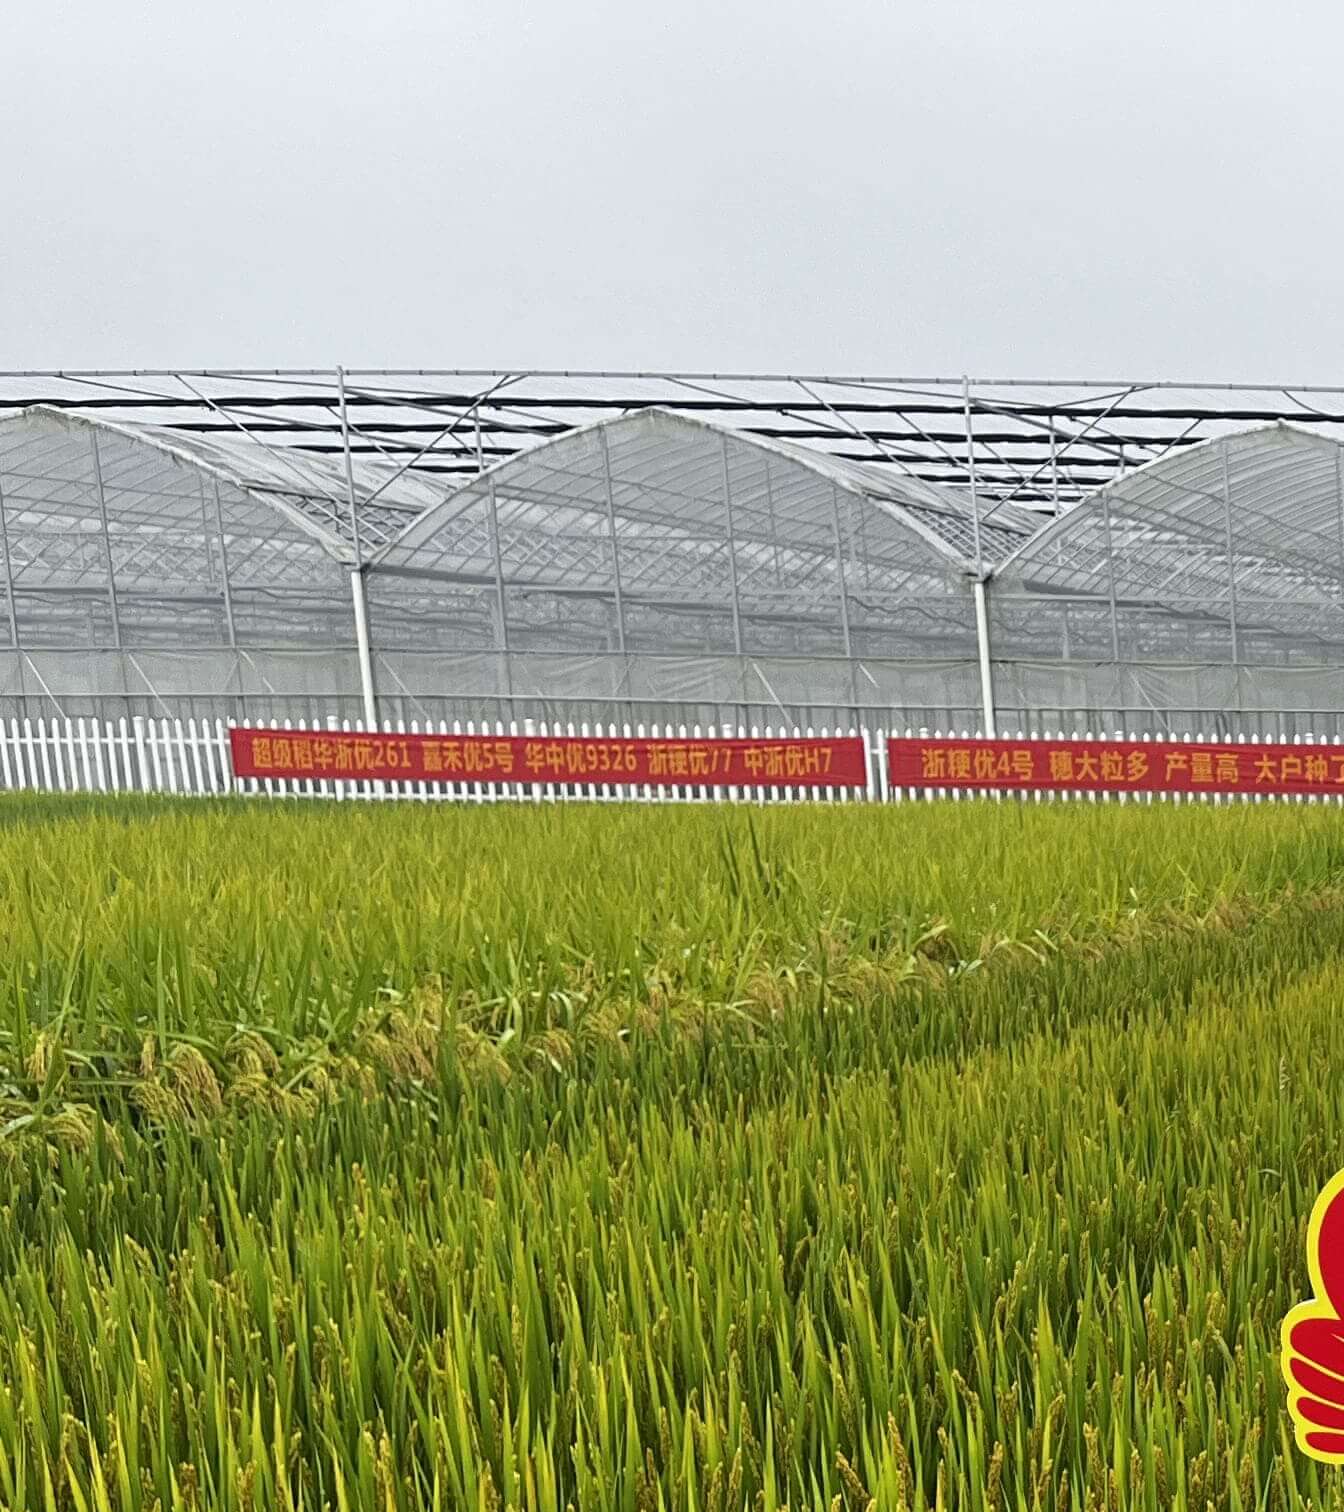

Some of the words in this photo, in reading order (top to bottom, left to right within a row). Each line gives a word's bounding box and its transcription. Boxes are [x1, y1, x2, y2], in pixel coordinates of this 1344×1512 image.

[525, 742, 637, 774] 华中优9326
[1049, 750, 1149, 782] 穗大粒多
[1165, 751, 1239, 784] 产量高
